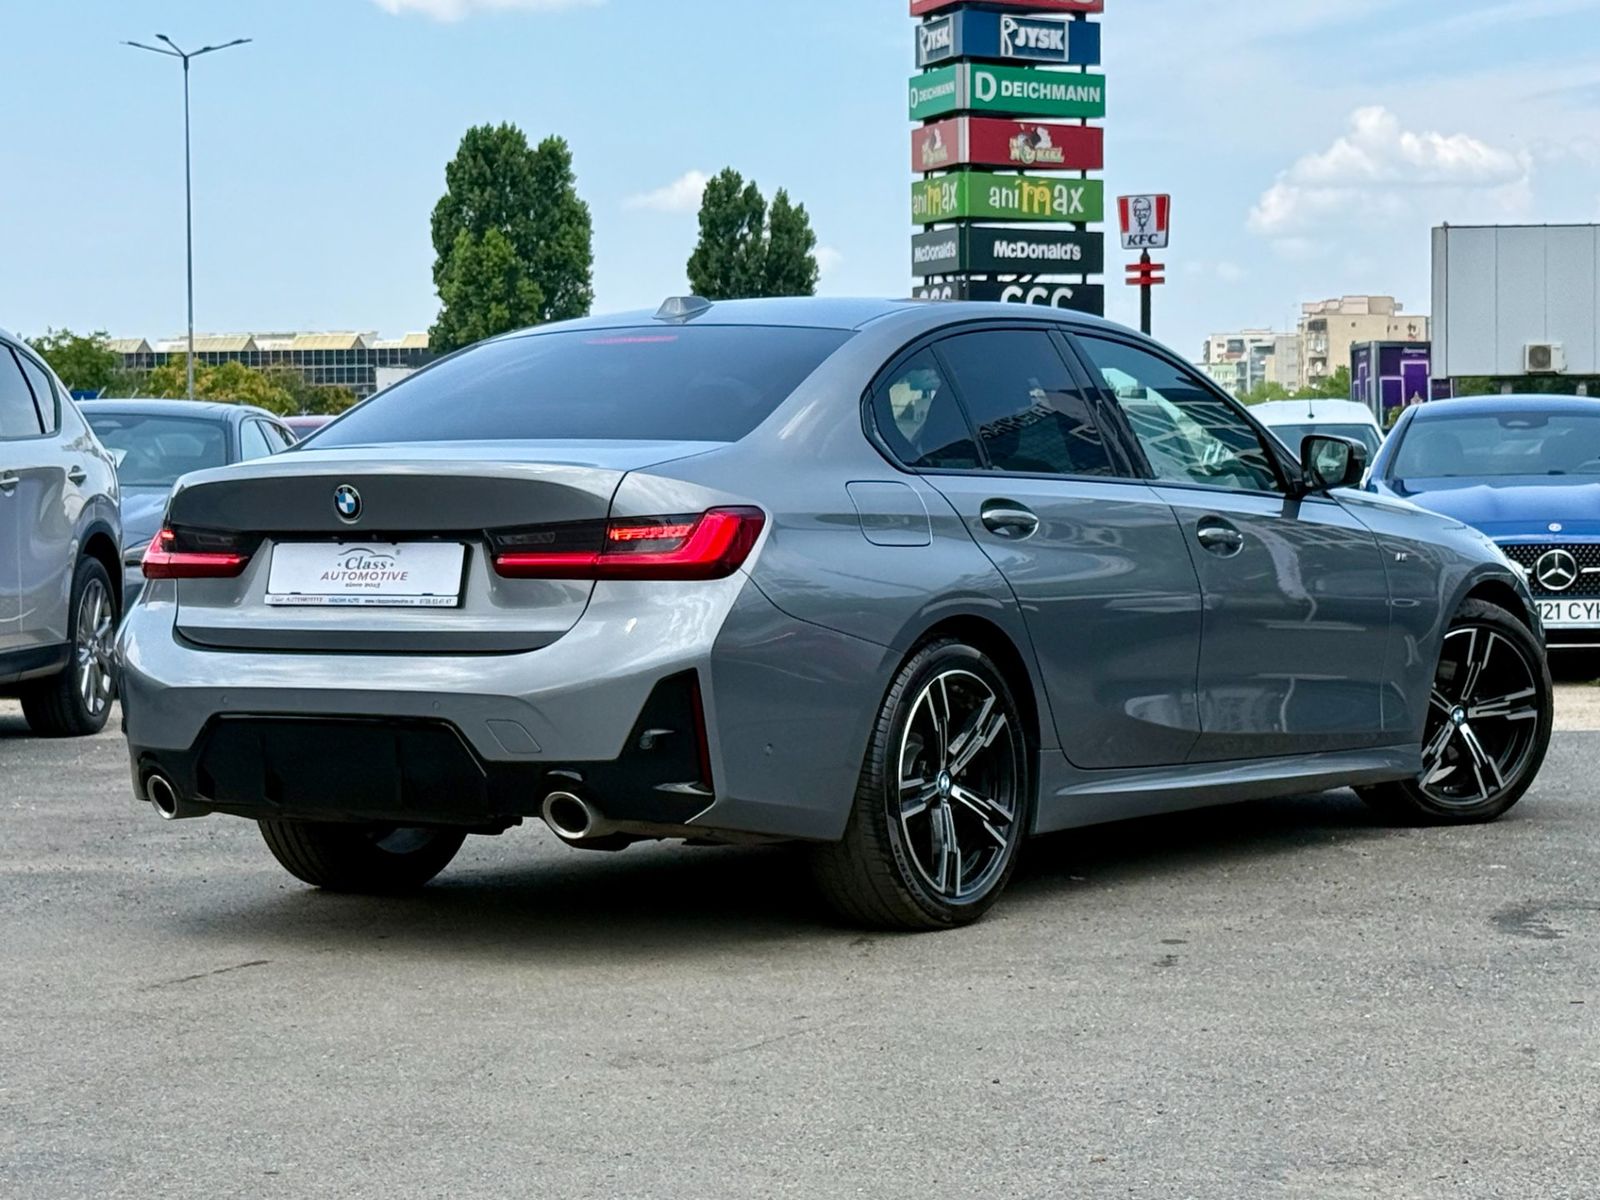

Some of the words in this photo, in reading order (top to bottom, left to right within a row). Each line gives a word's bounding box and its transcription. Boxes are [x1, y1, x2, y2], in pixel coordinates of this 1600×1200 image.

[926, 26, 950, 52] JYSK
[1014, 26, 1065, 51] JYSK
[918, 80, 956, 102] DEICHMANN
[1000, 79, 1101, 103] DEICHMANN
[912, 180, 958, 216] animax
[988, 179, 1085, 216] animax
[993, 240, 1082, 261] McDonald's
[1127, 233, 1159, 246] KFC
[913, 240, 957, 263] McDonald's
[345, 556, 388, 570] Class
[320, 571, 409, 581] AUTOMOTIVE
[1535, 602, 1561, 620] 121
